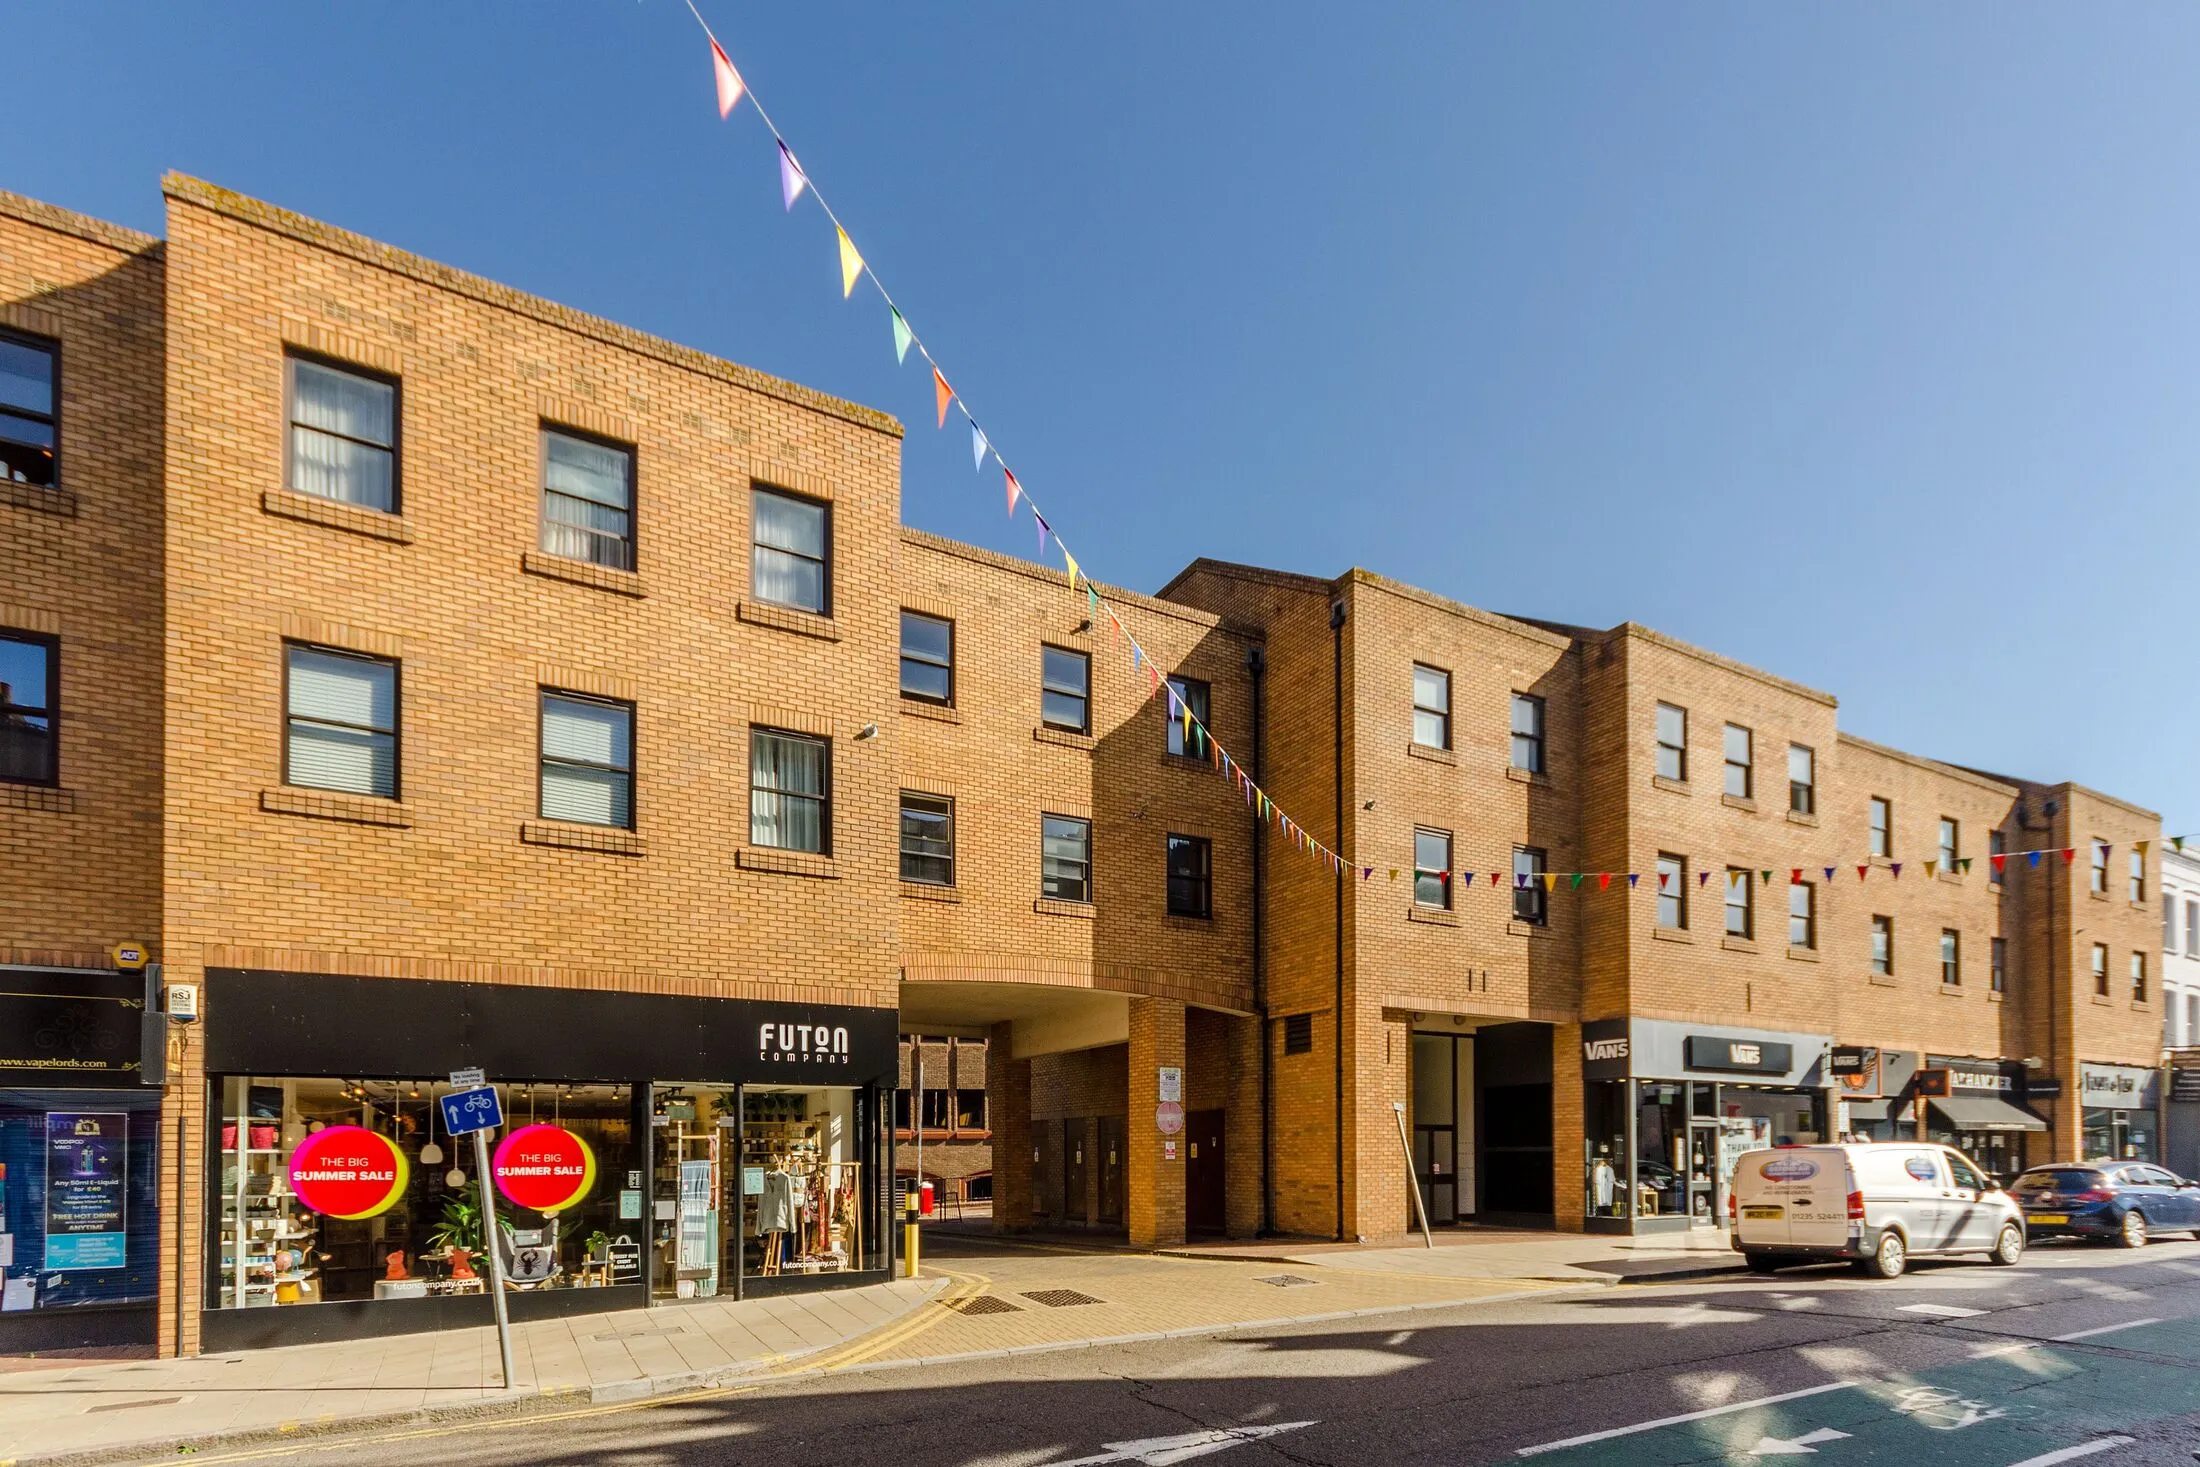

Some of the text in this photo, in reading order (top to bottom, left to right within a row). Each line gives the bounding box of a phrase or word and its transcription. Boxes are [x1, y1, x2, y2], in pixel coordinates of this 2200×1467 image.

[121, 951, 139, 959] ADT
[760, 1023, 848, 1053] FUTON
[1584, 1038, 1629, 1061] VANS
[1729, 1043, 1761, 1065] VANS
[760, 1052, 848, 1064] COMPANY
[1834, 1055, 1860, 1067] VANS
[320, 1157, 369, 1167] THE BIG
[520, 1153, 562, 1163] THE BIG
[293, 1171, 394, 1181] SUMMER SALE
[497, 1166, 583, 1177] SUMMER SALE
[393, 1277, 482, 1291] futoncompany.co.uk
